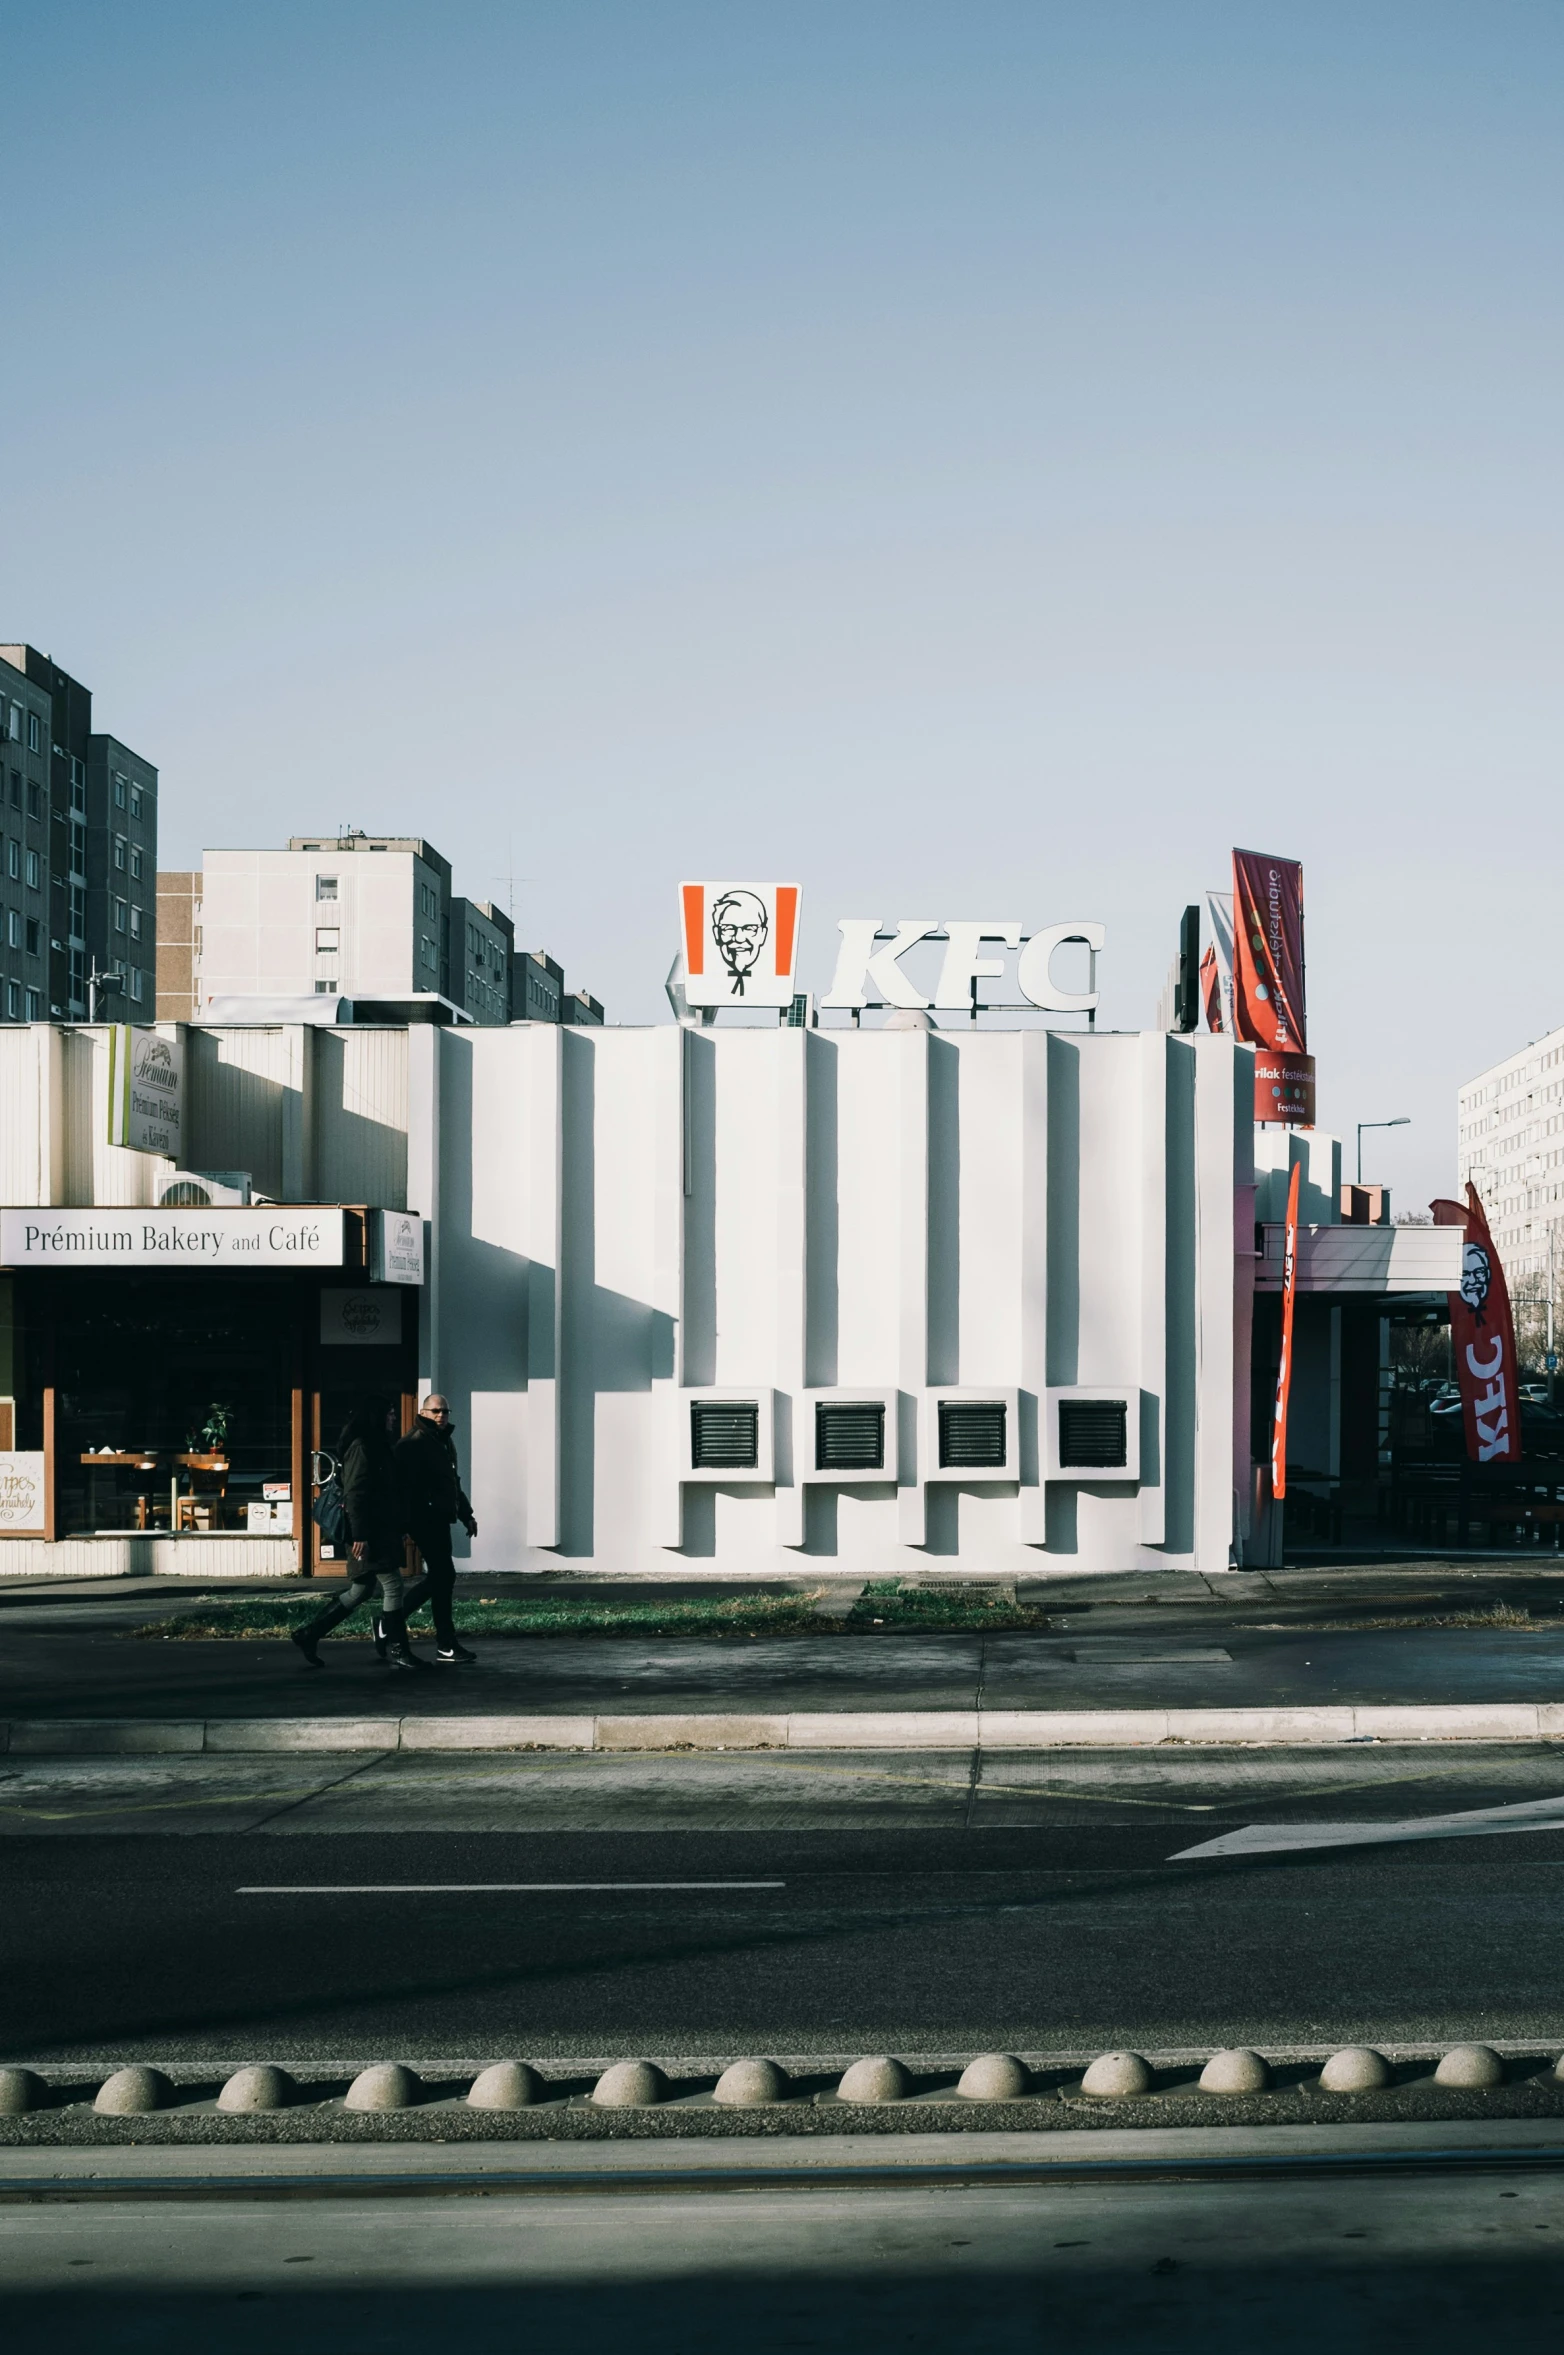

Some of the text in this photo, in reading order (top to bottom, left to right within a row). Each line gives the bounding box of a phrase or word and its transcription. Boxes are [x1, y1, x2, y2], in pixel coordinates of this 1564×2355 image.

[820, 919, 1106, 1011] KFC
[1254, 1067, 1281, 1079] rilak
[25, 1225, 320, 1257] Prémium Bakery and Café
[1466, 1335, 1509, 1461] KFC
